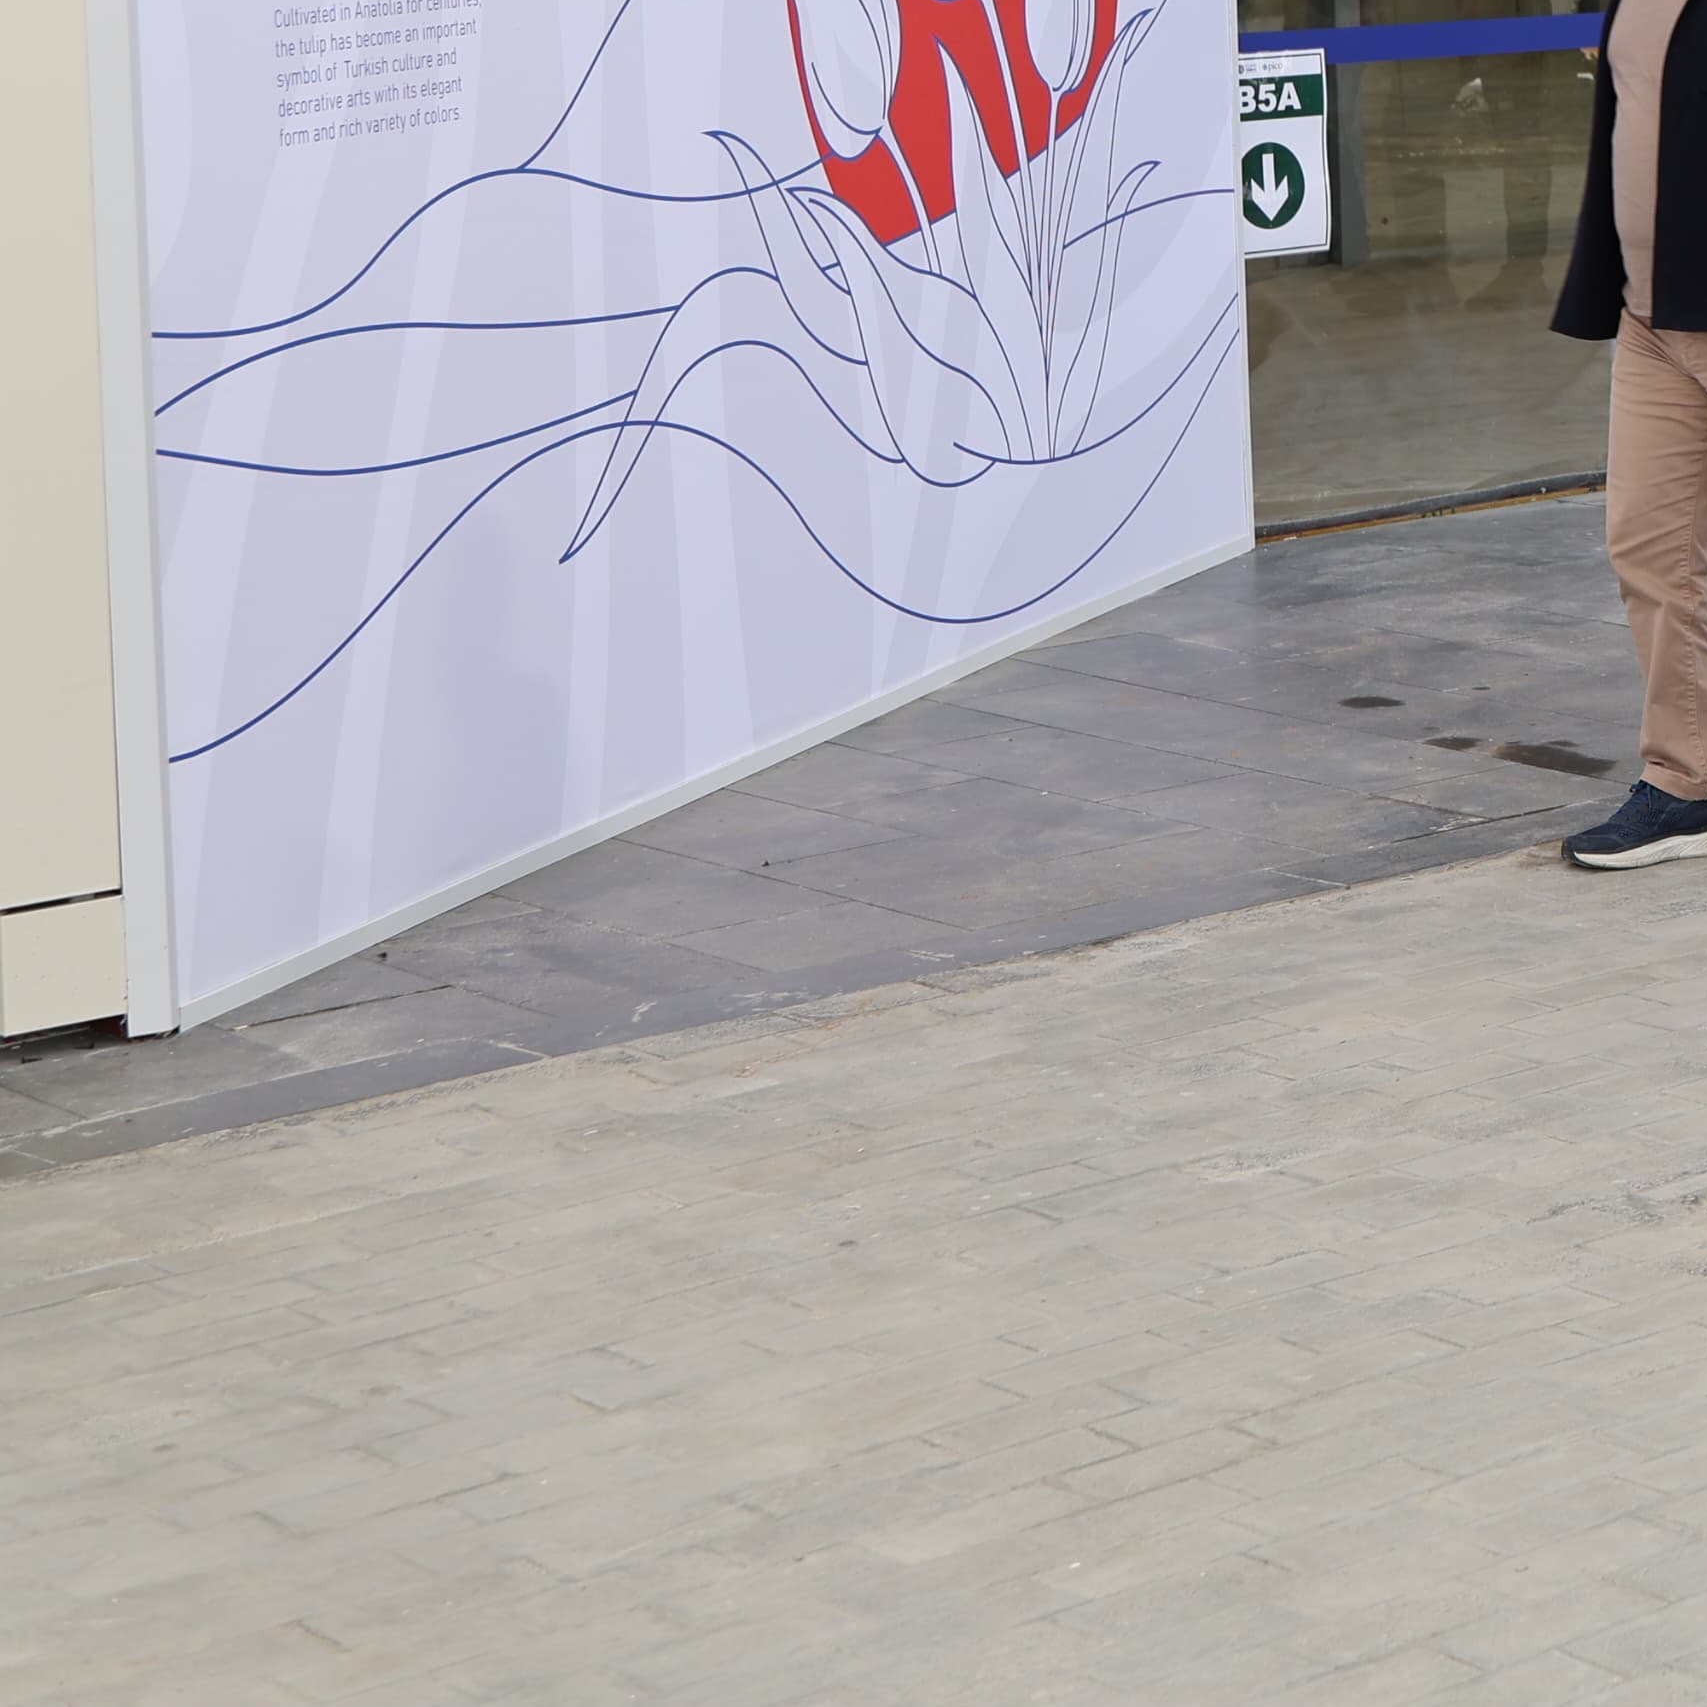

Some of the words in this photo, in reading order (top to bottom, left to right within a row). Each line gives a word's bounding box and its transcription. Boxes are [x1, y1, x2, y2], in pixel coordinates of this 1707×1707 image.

[274, 4, 336, 28] Cultivated
[340, 1, 352, 21] in
[275, 38, 296, 58] the
[300, 33, 327, 58] tulip
[330, 32, 353, 52] has
[355, 29, 402, 49] become
[405, 27, 420, 43] an
[422, 18, 477, 44] important
[276, 64, 322, 92] symbol
[325, 61, 338, 82] of
[344, 55, 389, 79] Turkish
[392, 52, 433, 73] culture
[436, 46, 457, 67] and
[278, 93, 344, 118] decorative
[346, 89, 371, 108] arts
[374, 82, 400, 103] with
[403, 80, 418, 100] its
[421, 74, 462, 100] elegant
[279, 127, 311, 148] form
[313, 120, 336, 143] and
[339, 117, 363, 138] rich
[366, 111, 406, 134] variety
[410, 107, 422, 128] of
